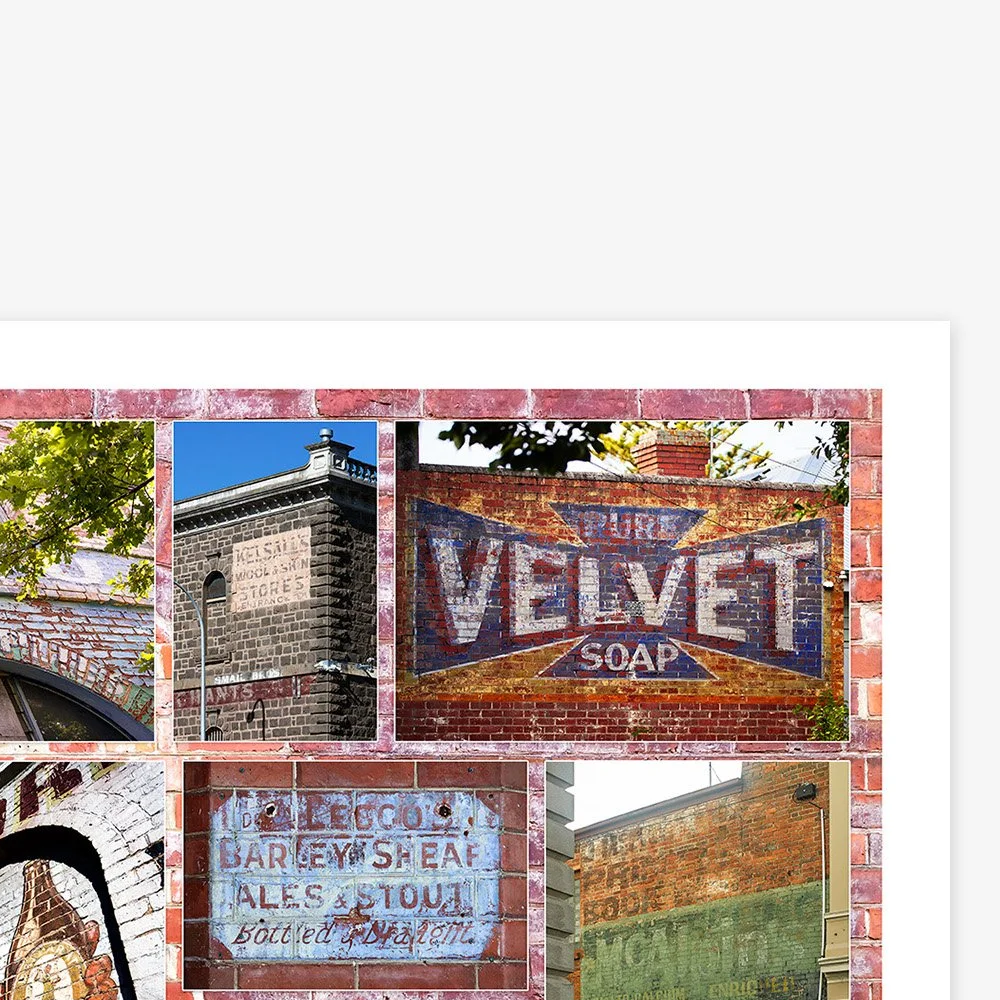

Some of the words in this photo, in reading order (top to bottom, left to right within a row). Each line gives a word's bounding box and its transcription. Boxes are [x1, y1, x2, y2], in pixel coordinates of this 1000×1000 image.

[427, 535, 820, 652] VELVET
[580, 642, 680, 674] SOAP
[219, 836, 352, 870] BARLEY
[236, 883, 323, 910] ALES
[357, 882, 462, 910] STOUT
